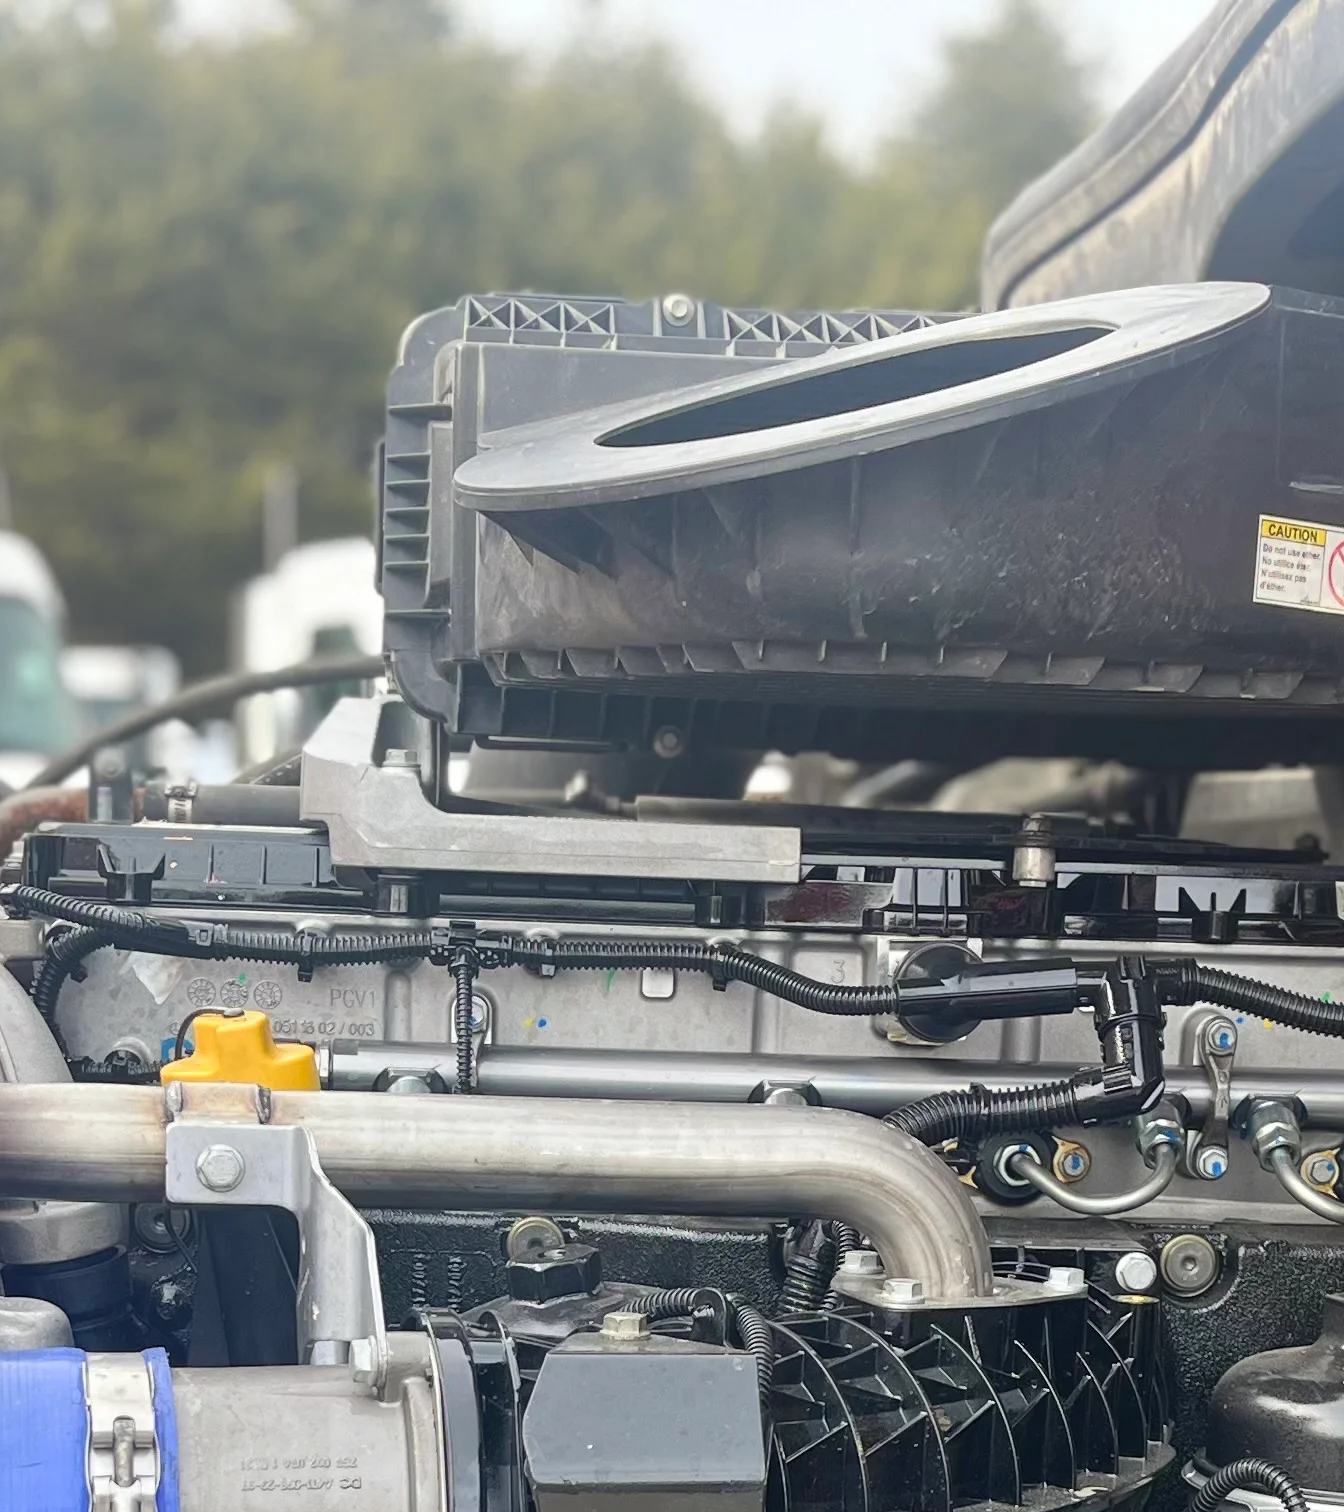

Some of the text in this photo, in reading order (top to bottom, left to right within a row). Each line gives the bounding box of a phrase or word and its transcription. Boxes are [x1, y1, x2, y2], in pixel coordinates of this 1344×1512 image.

[1268, 523, 1318, 542] CAUTION
[1262, 543, 1273, 553] Do
[1274, 546, 1286, 556] not
[1287, 549, 1301, 557] use
[1262, 556, 1272, 565] No
